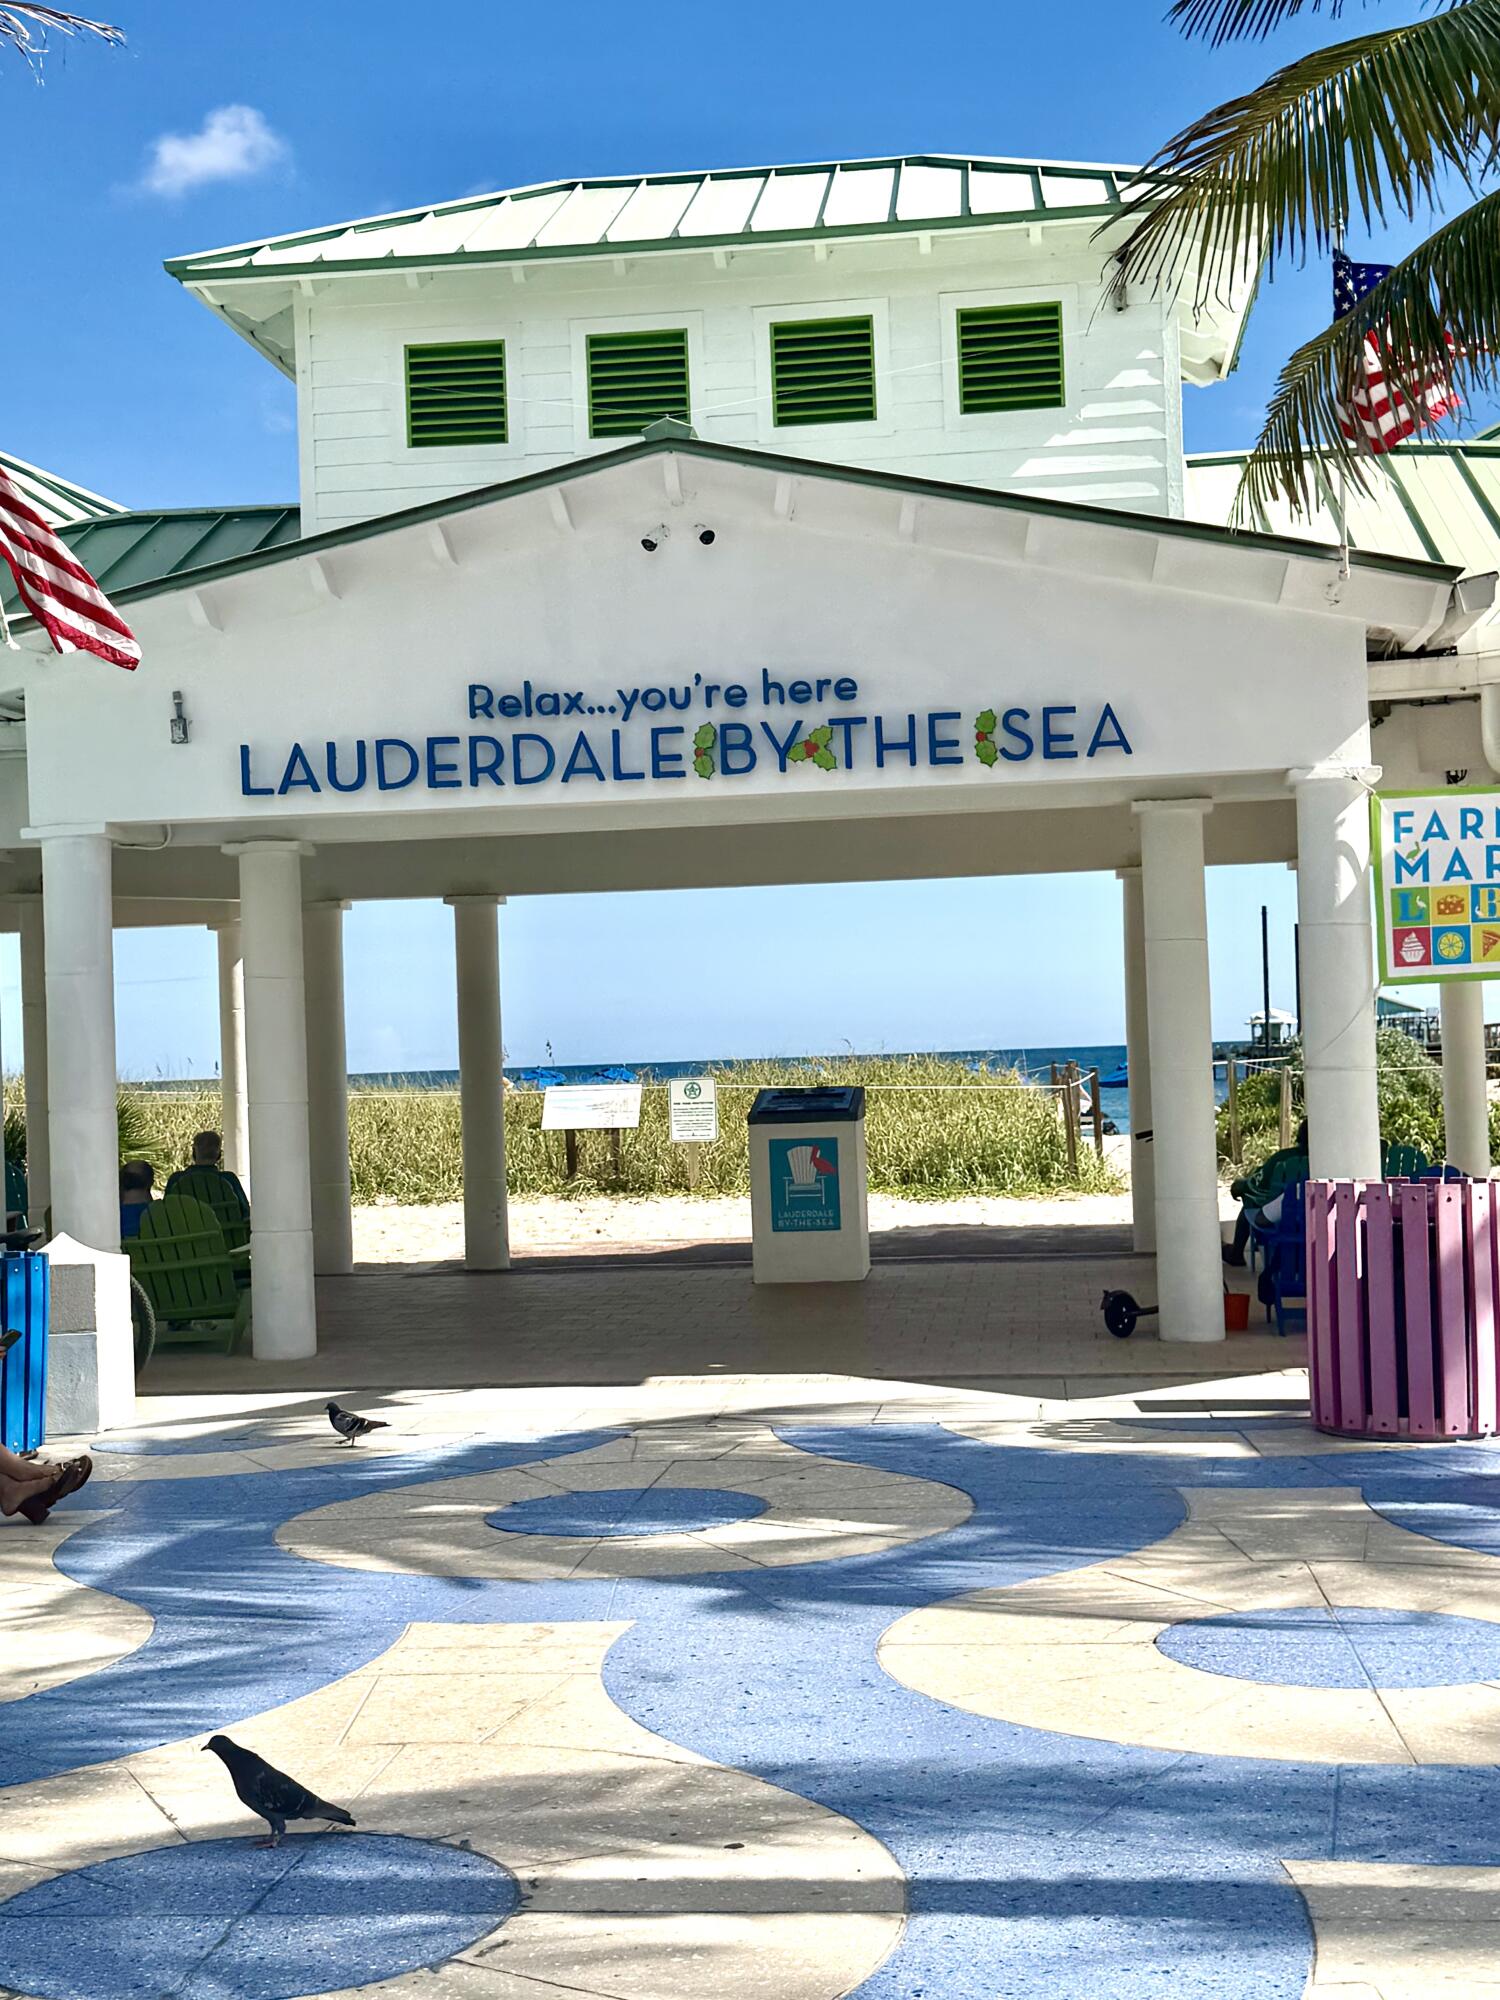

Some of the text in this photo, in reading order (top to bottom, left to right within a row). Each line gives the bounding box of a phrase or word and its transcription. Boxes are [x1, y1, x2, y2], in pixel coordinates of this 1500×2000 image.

[762, 669, 858, 706] here
[240, 702, 1133, 796] LAUDERDALE BY THE SEA
